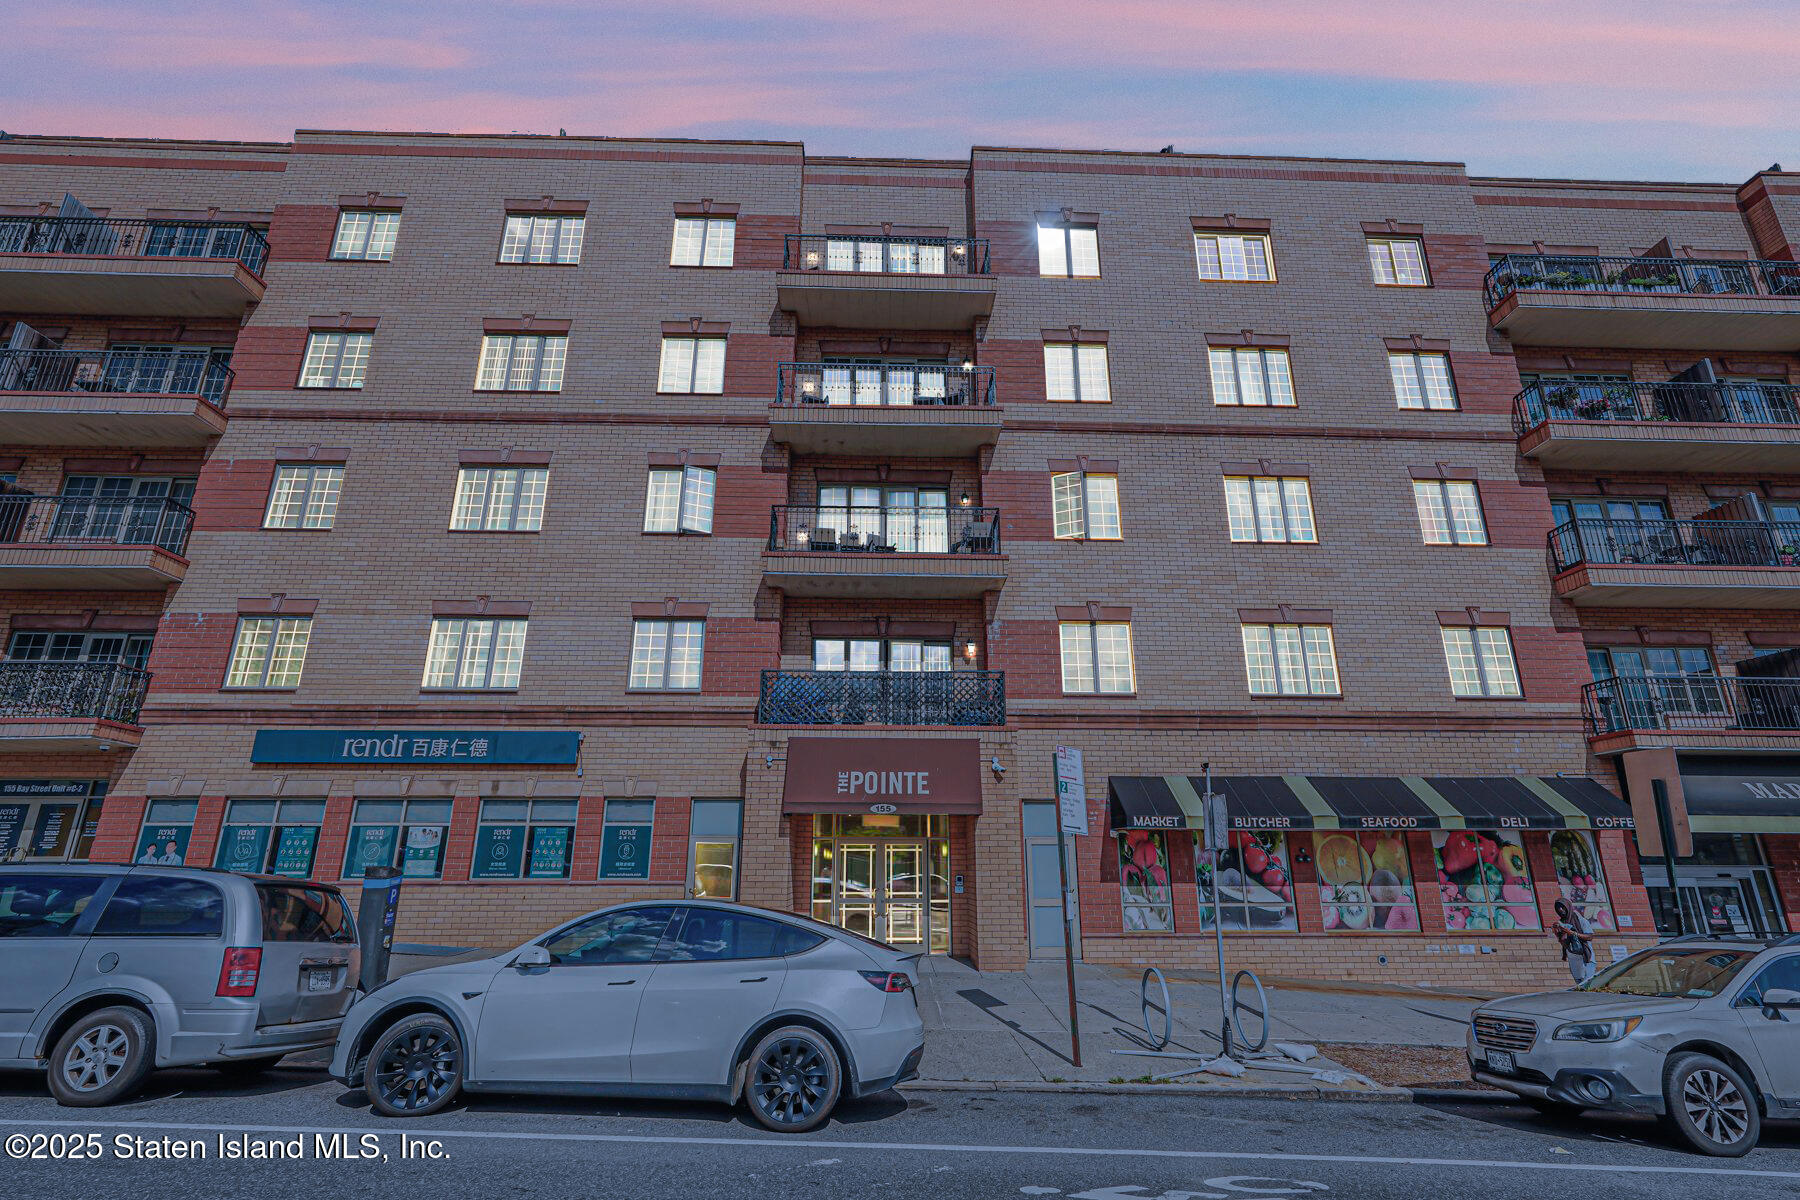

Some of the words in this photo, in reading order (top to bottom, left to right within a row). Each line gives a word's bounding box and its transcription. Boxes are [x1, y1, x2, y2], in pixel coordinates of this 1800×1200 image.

[342, 734, 408, 758] rendr
[412, 737, 488, 758] 百康仁德
[837, 771, 848, 794] THE
[850, 771, 929, 795] POINTE
[4, 784, 16, 793] 155
[17, 784, 30, 793] Bay
[30, 784, 50, 793] Street
[51, 784, 65, 793] Unit
[875, 804, 891, 813] 155
[1133, 816, 1179, 827] MARKET
[1235, 817, 1290, 828] BUTCHER
[1362, 817, 1417, 828] SEAFOOD
[1501, 817, 1530, 828] DELI
[1596, 817, 1636, 828] COFFE
[158, 828, 177, 836] rendr
[493, 828, 512, 836] rendr
[619, 828, 637, 836] rendr
